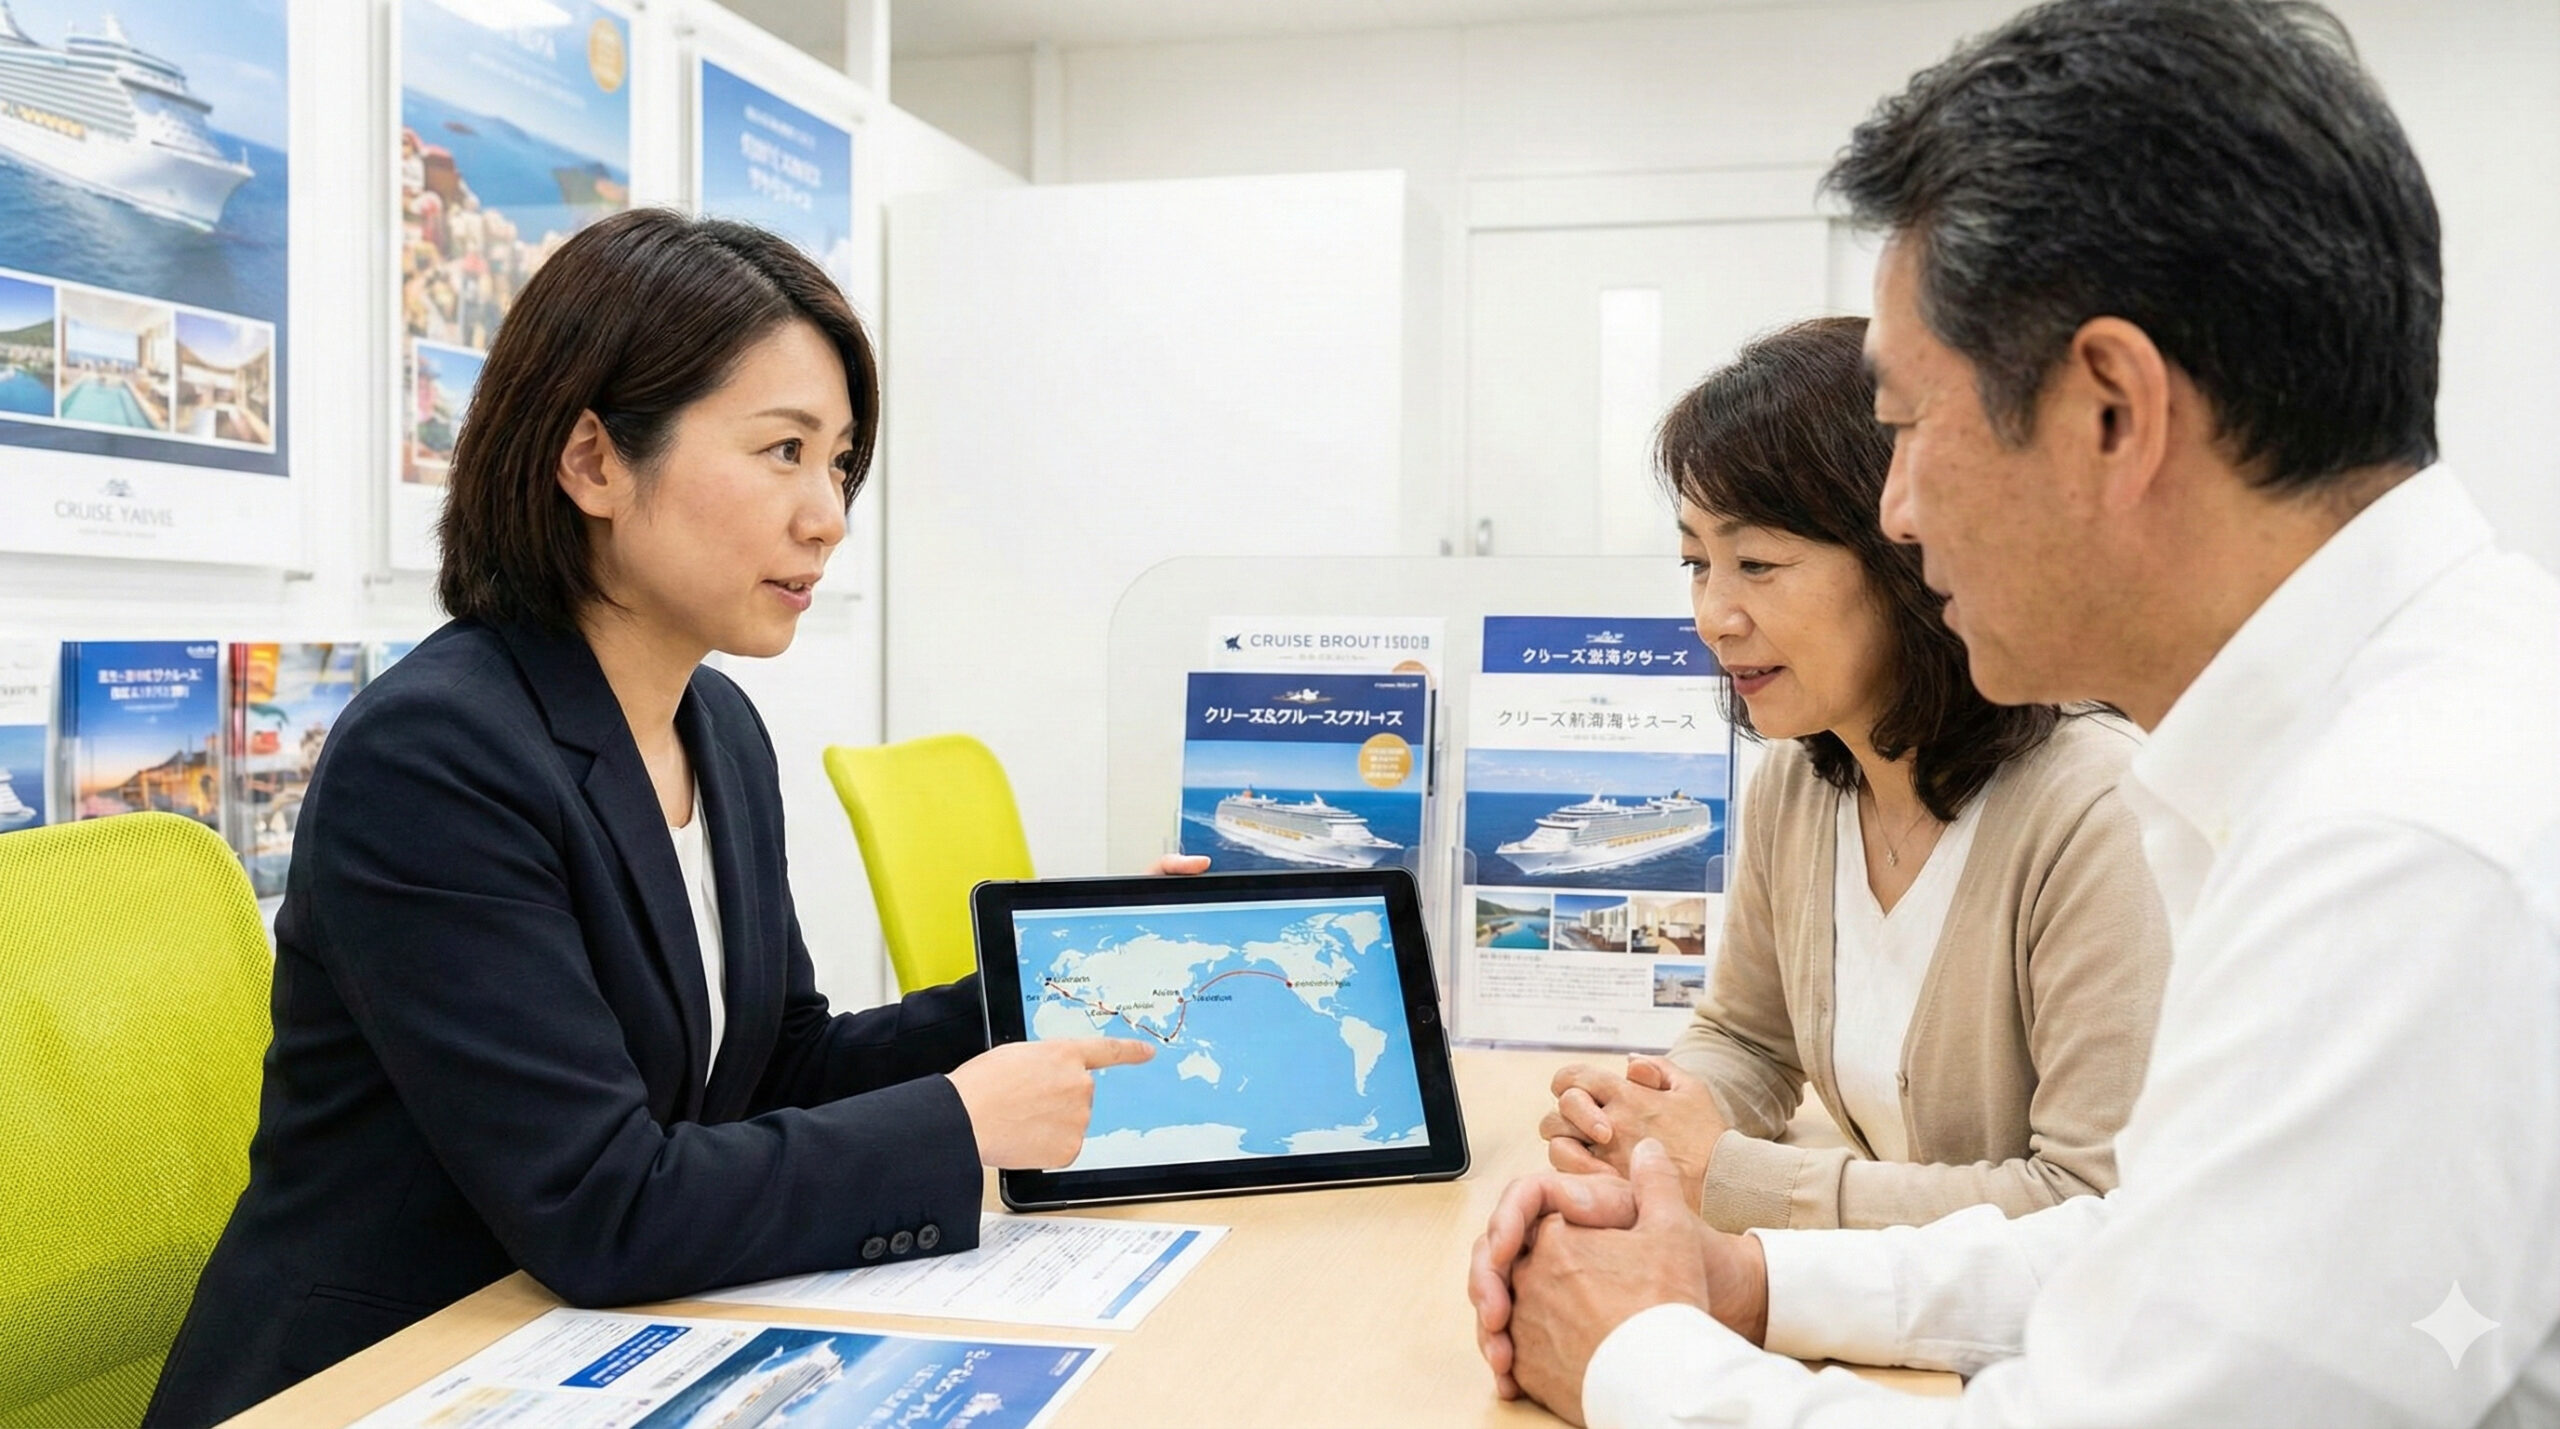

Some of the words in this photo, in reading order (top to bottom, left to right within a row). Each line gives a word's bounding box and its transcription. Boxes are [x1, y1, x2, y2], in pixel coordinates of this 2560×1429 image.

[54, 499, 114, 523] CRUISE
[1250, 633, 1313, 648] CRUISE
[1319, 634, 1381, 649] BROUT
